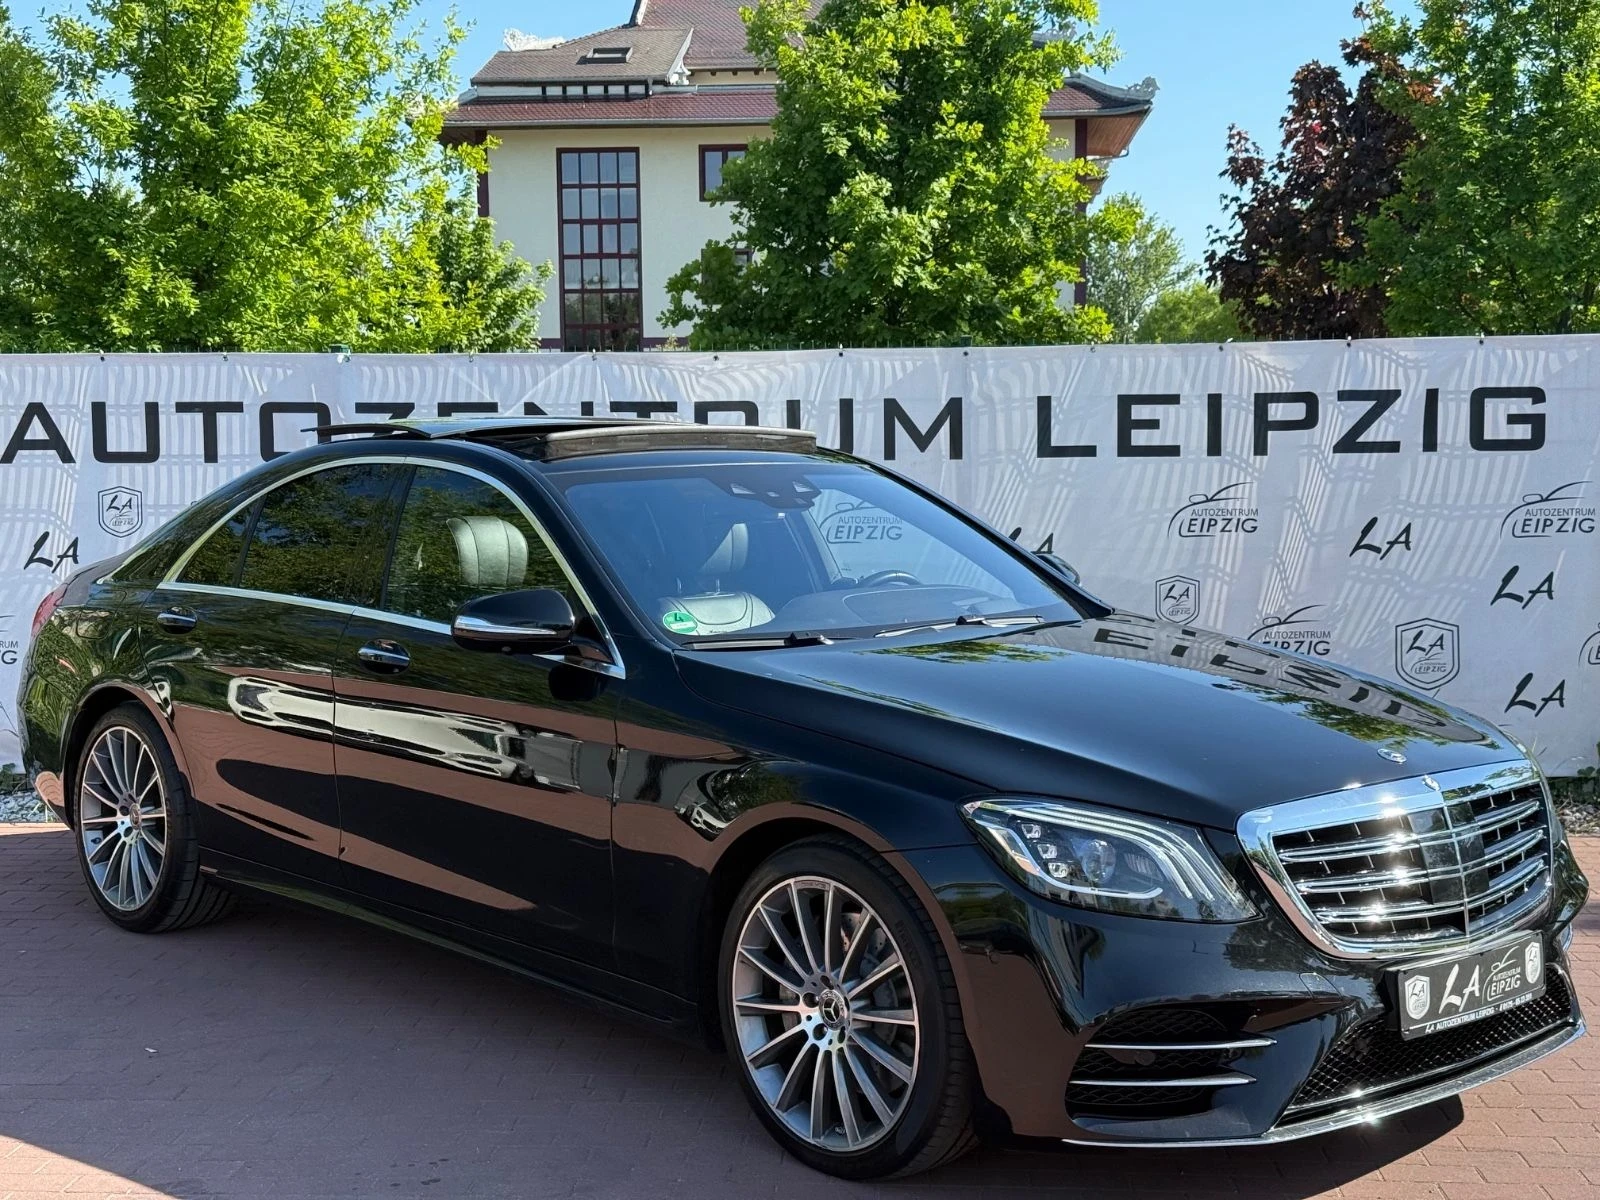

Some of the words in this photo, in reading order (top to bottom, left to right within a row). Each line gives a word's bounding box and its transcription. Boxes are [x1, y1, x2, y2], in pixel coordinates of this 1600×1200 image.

[0, 397, 963, 464] AUTOUM
[1036, 386, 1547, 458] LEIPZIG
[106, 494, 132, 513] LA
[1191, 508, 1259, 517] AUTOZENTRUM
[1524, 507, 1596, 517] AUTOZENTRUM
[838, 516, 903, 524] AUTOZENTRUM
[1349, 516, 1412, 560] LA
[23, 530, 79, 574] LA
[1163, 583, 1190, 603] LA
[1490, 565, 1554, 609] LA
[1264, 630, 1331, 640] AUTOZENTRUM
[1405, 629, 1444, 656] LA
[1504, 672, 1566, 717] LA
[1438, 963, 1480, 1014] LA
